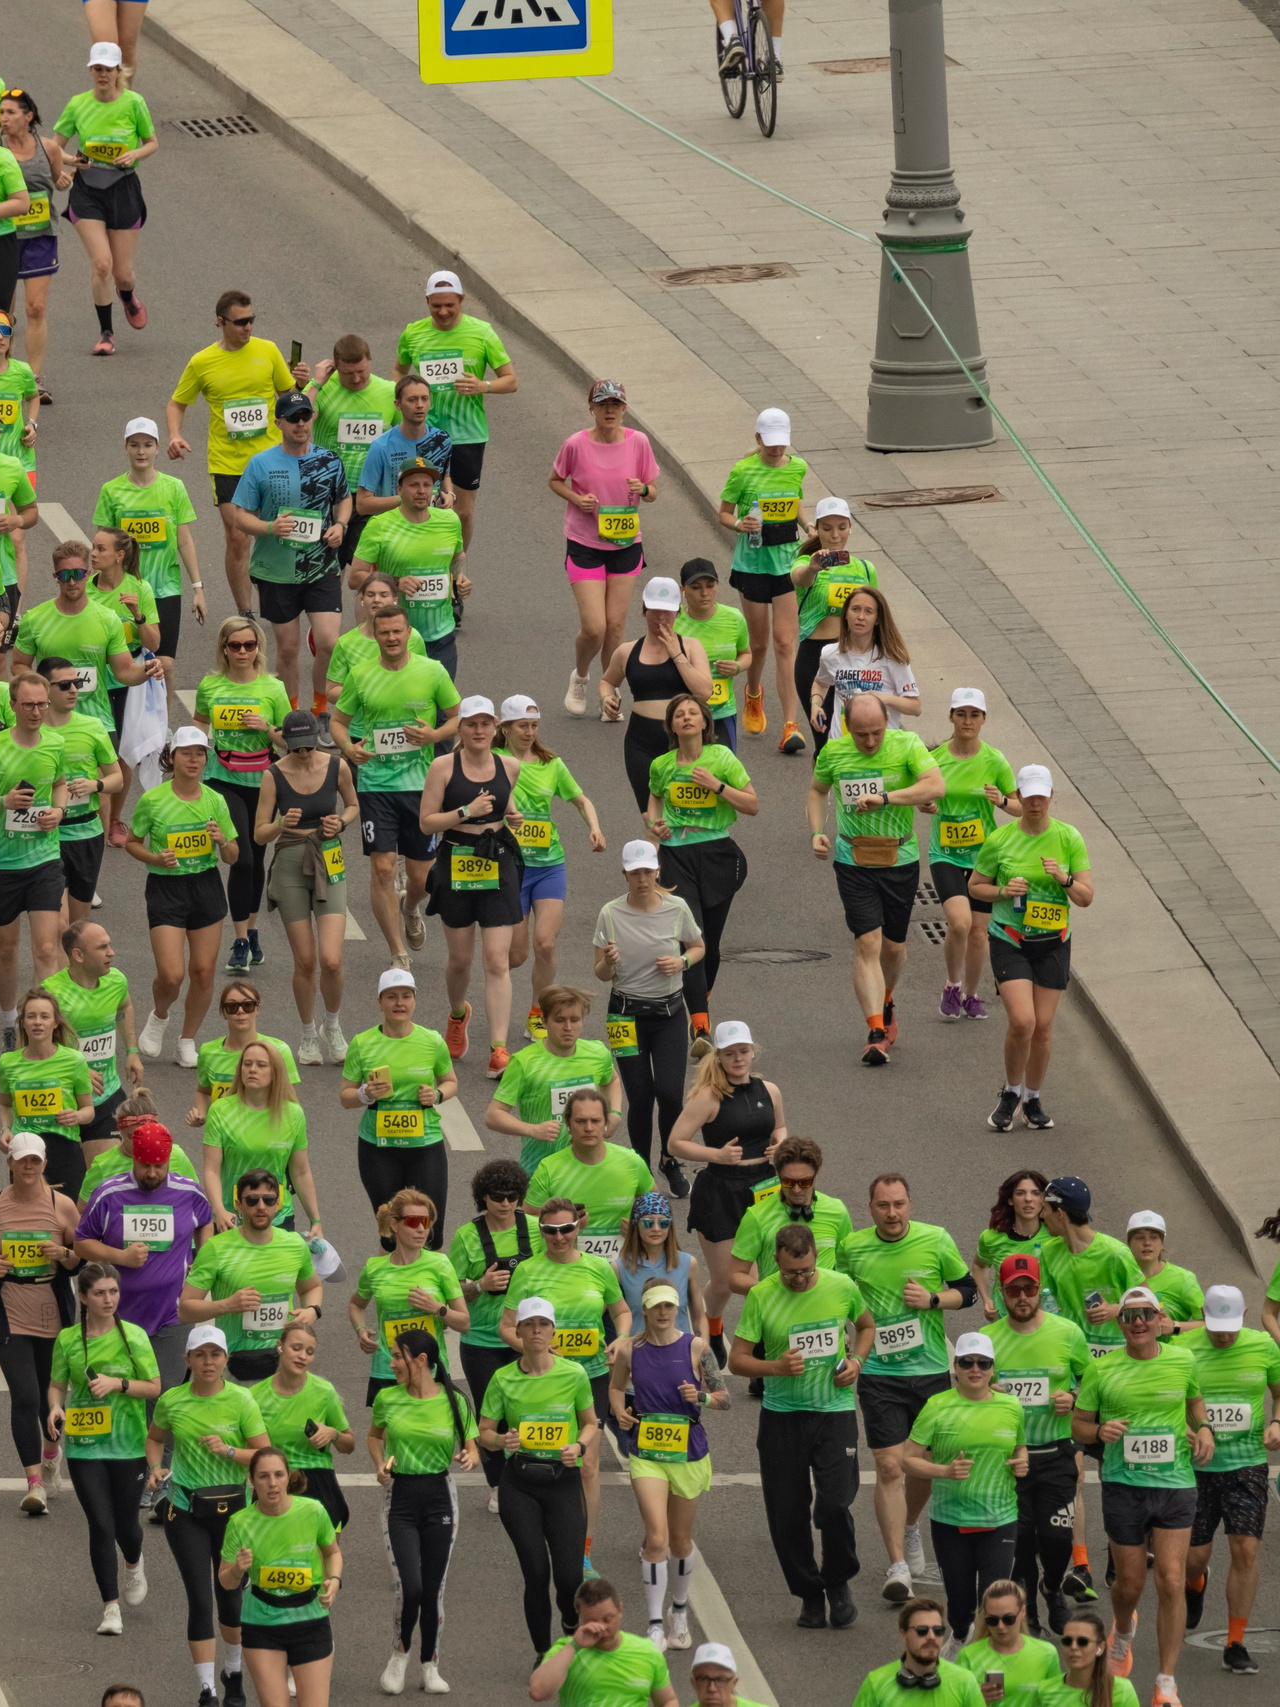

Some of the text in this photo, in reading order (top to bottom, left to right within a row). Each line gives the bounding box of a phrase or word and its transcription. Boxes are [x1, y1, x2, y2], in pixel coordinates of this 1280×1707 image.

[91, 145, 123, 156] 3037
[426, 363, 458, 376] 5263
[231, 409, 263, 423] 9868
[346, 423, 376, 436] 1418
[762, 501, 793, 513] 5337
[127, 521, 160, 534] 4308
[605, 518, 635, 531] 3788
[380, 732, 406, 745] 475
[677, 785, 709, 800] 3509
[845, 782, 877, 797] 3318
[514, 826, 545, 839] 4806
[946, 825, 977, 839] 5122
[174, 835, 207, 849] 4050
[458, 859, 492, 872] 3896
[1032, 906, 1061, 921] 5335
[83, 1036, 112, 1052] 4077
[22, 1093, 56, 1107] 1622
[384, 1115, 417, 1129] 5480
[131, 1218, 167, 1232] 1950
[10, 1245, 44, 1258] 1953
[585, 1239, 619, 1254] 2474
[253, 1306, 283, 1322] 1586
[558, 1333, 593, 1348] 1284
[796, 1332, 834, 1350] 5915
[879, 1325, 915, 1345] 5895
[72, 1411, 104, 1426] 3230
[1207, 1408, 1243, 1422] 3126
[527, 1426, 563, 1441] 2187
[646, 1427, 681, 1442] 5894
[1131, 1439, 1168, 1454] 4188
[267, 1570, 305, 1586] 4893
